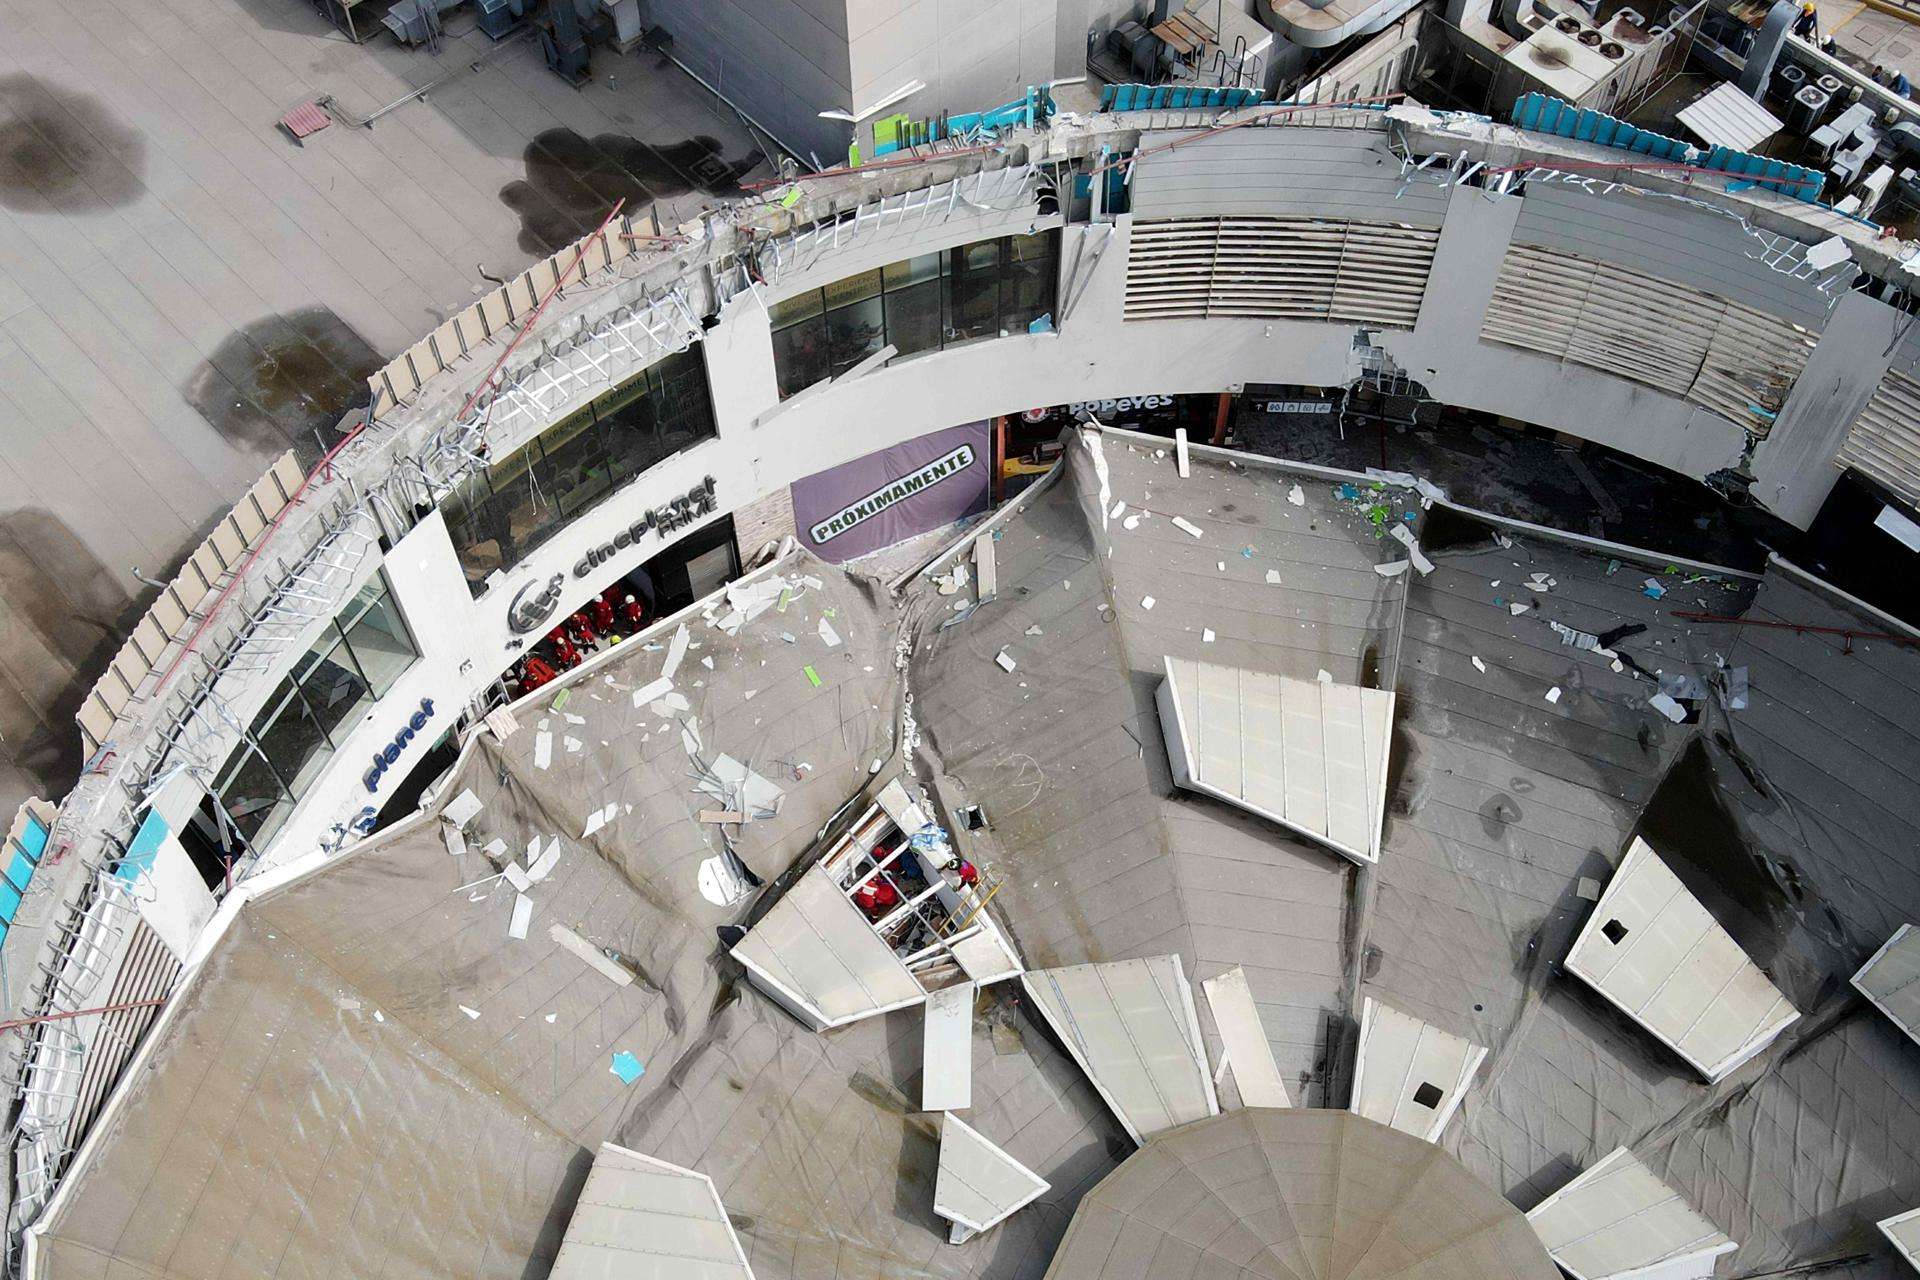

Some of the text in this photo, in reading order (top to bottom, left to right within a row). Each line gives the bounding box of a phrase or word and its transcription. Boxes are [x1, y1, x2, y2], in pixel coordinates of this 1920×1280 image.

[609, 376, 644, 404] PRIME
[573, 473, 718, 579] cineplanet
[658, 495, 718, 539] PRIME
[816, 450, 968, 541] PRÓXIMAMENTE
